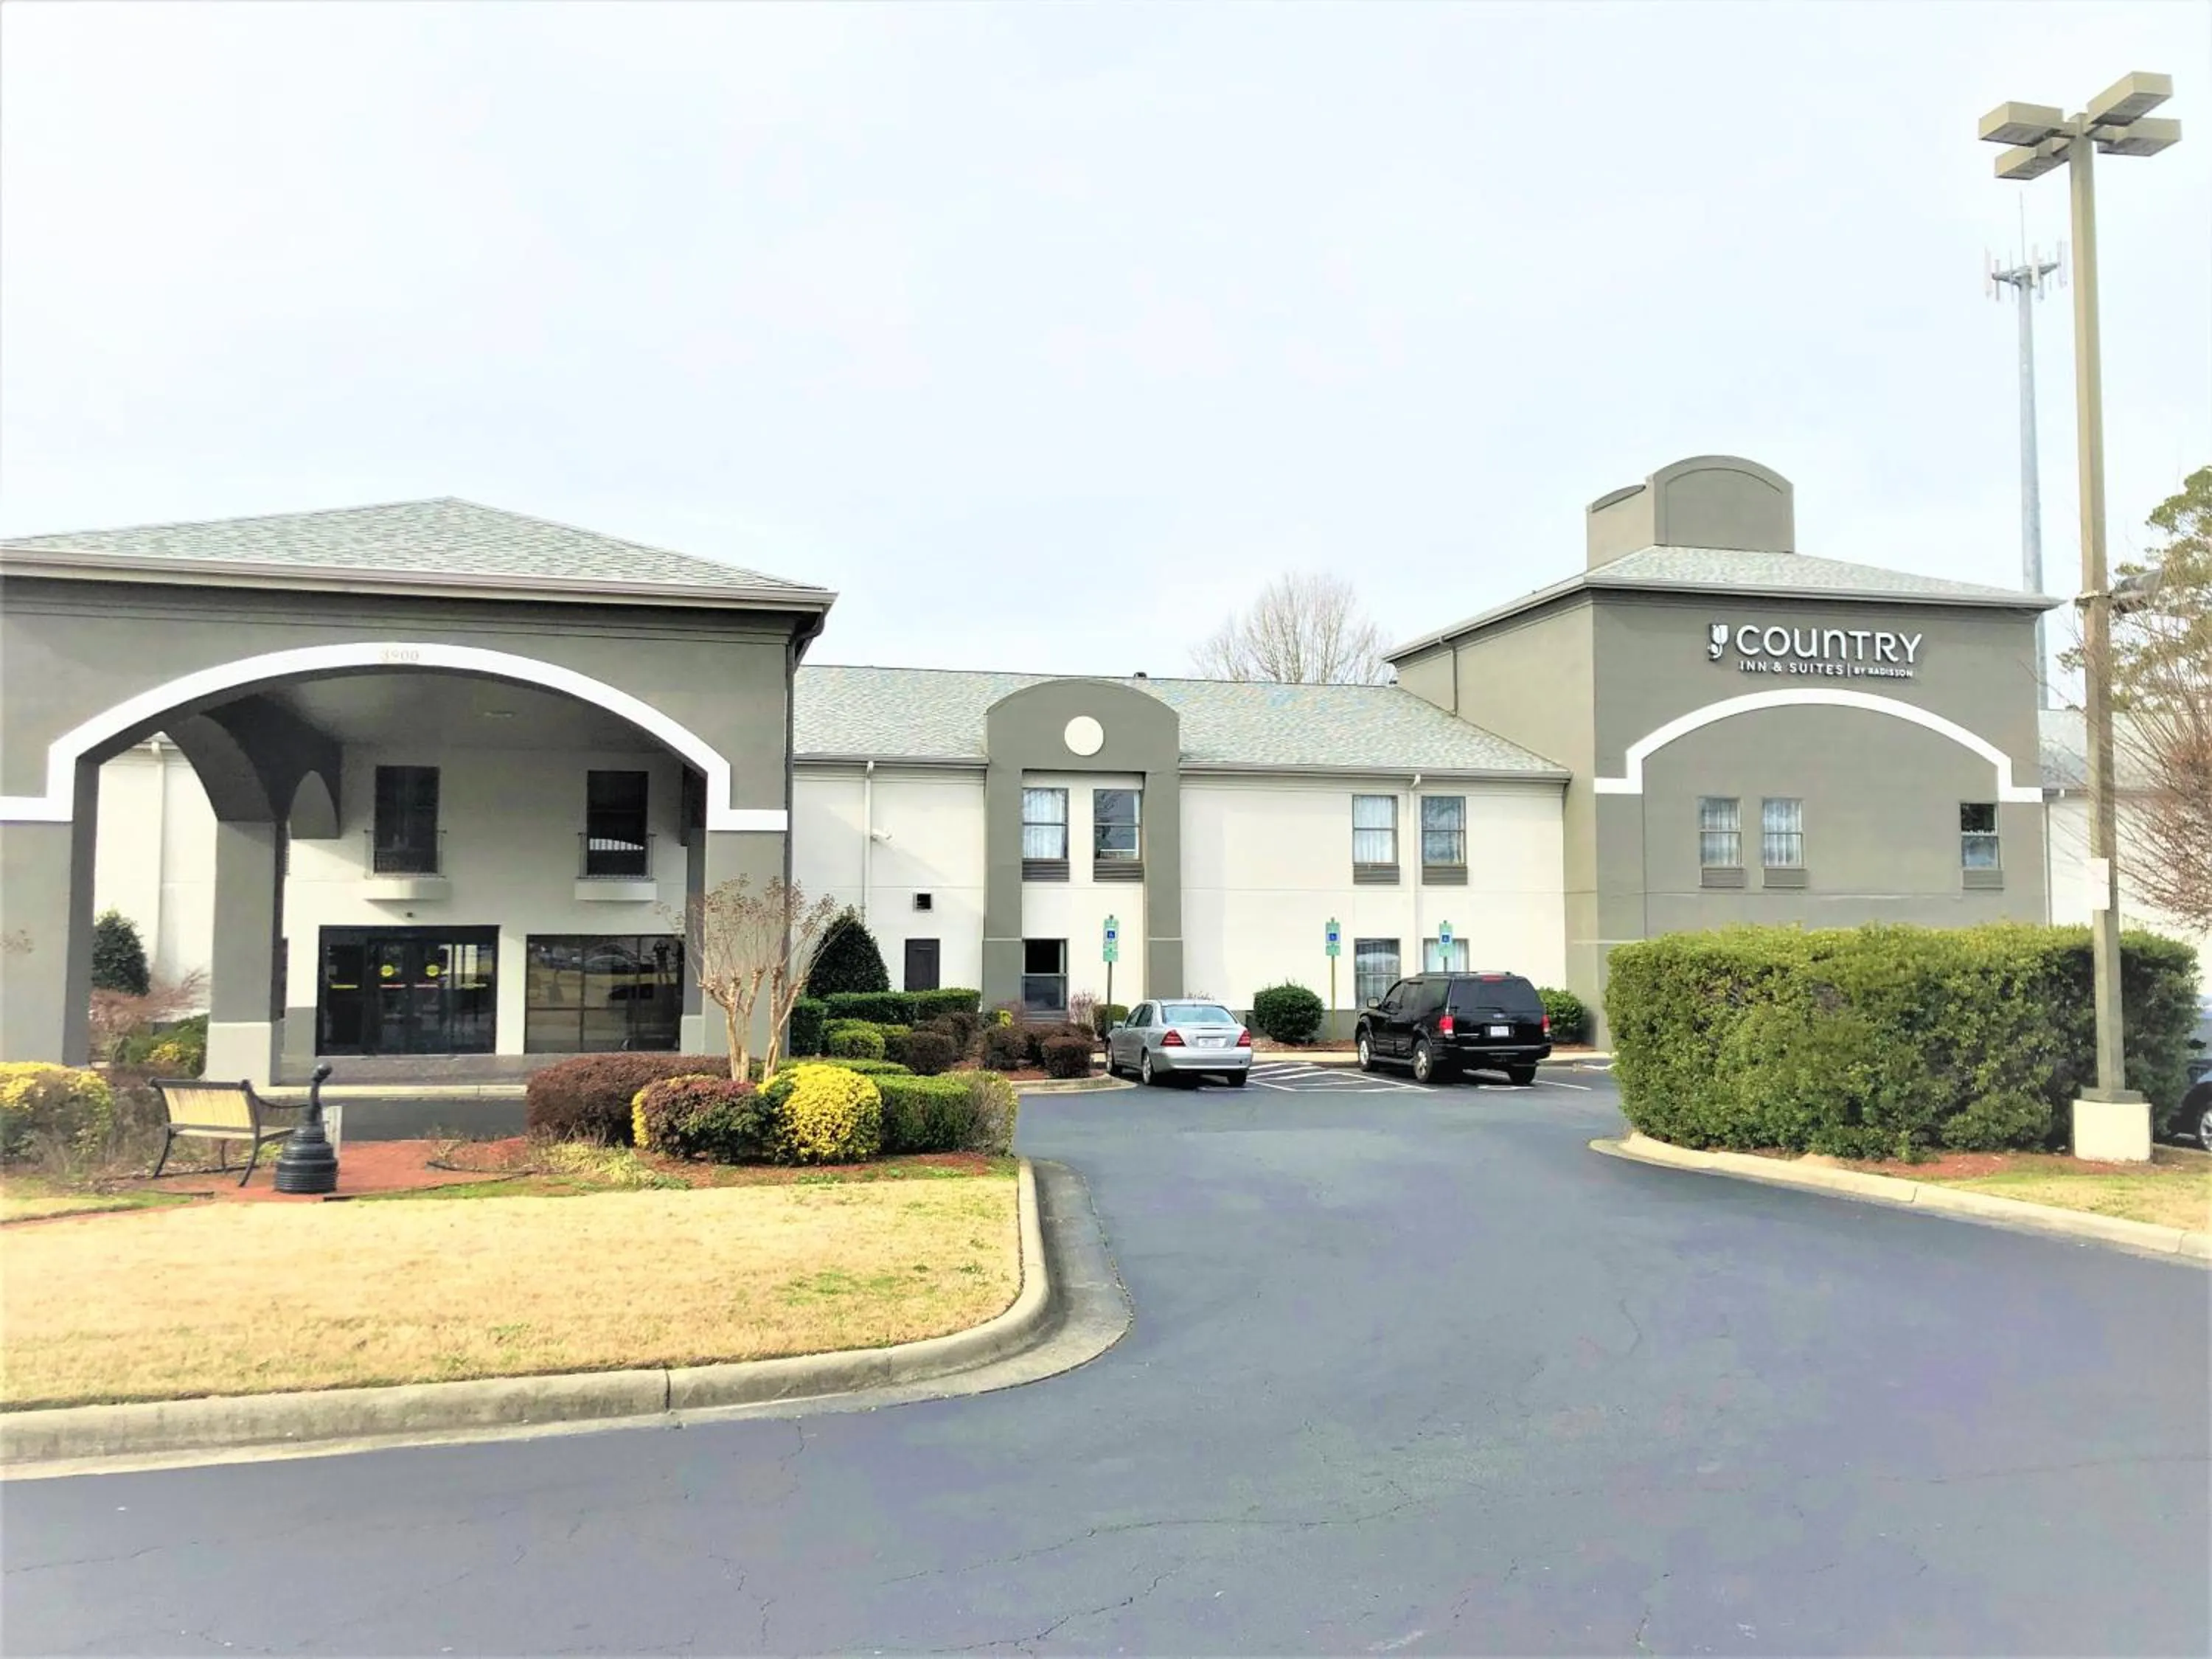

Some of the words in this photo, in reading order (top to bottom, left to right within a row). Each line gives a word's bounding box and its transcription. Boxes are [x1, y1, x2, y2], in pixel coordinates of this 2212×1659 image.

[1736, 625, 1923, 663] COUNTRY
[1739, 660, 1767, 672] INN
[1773, 661, 1783, 673] &
[1790, 662, 1844, 675] SUITES
[1854, 666, 1865, 675] BY
